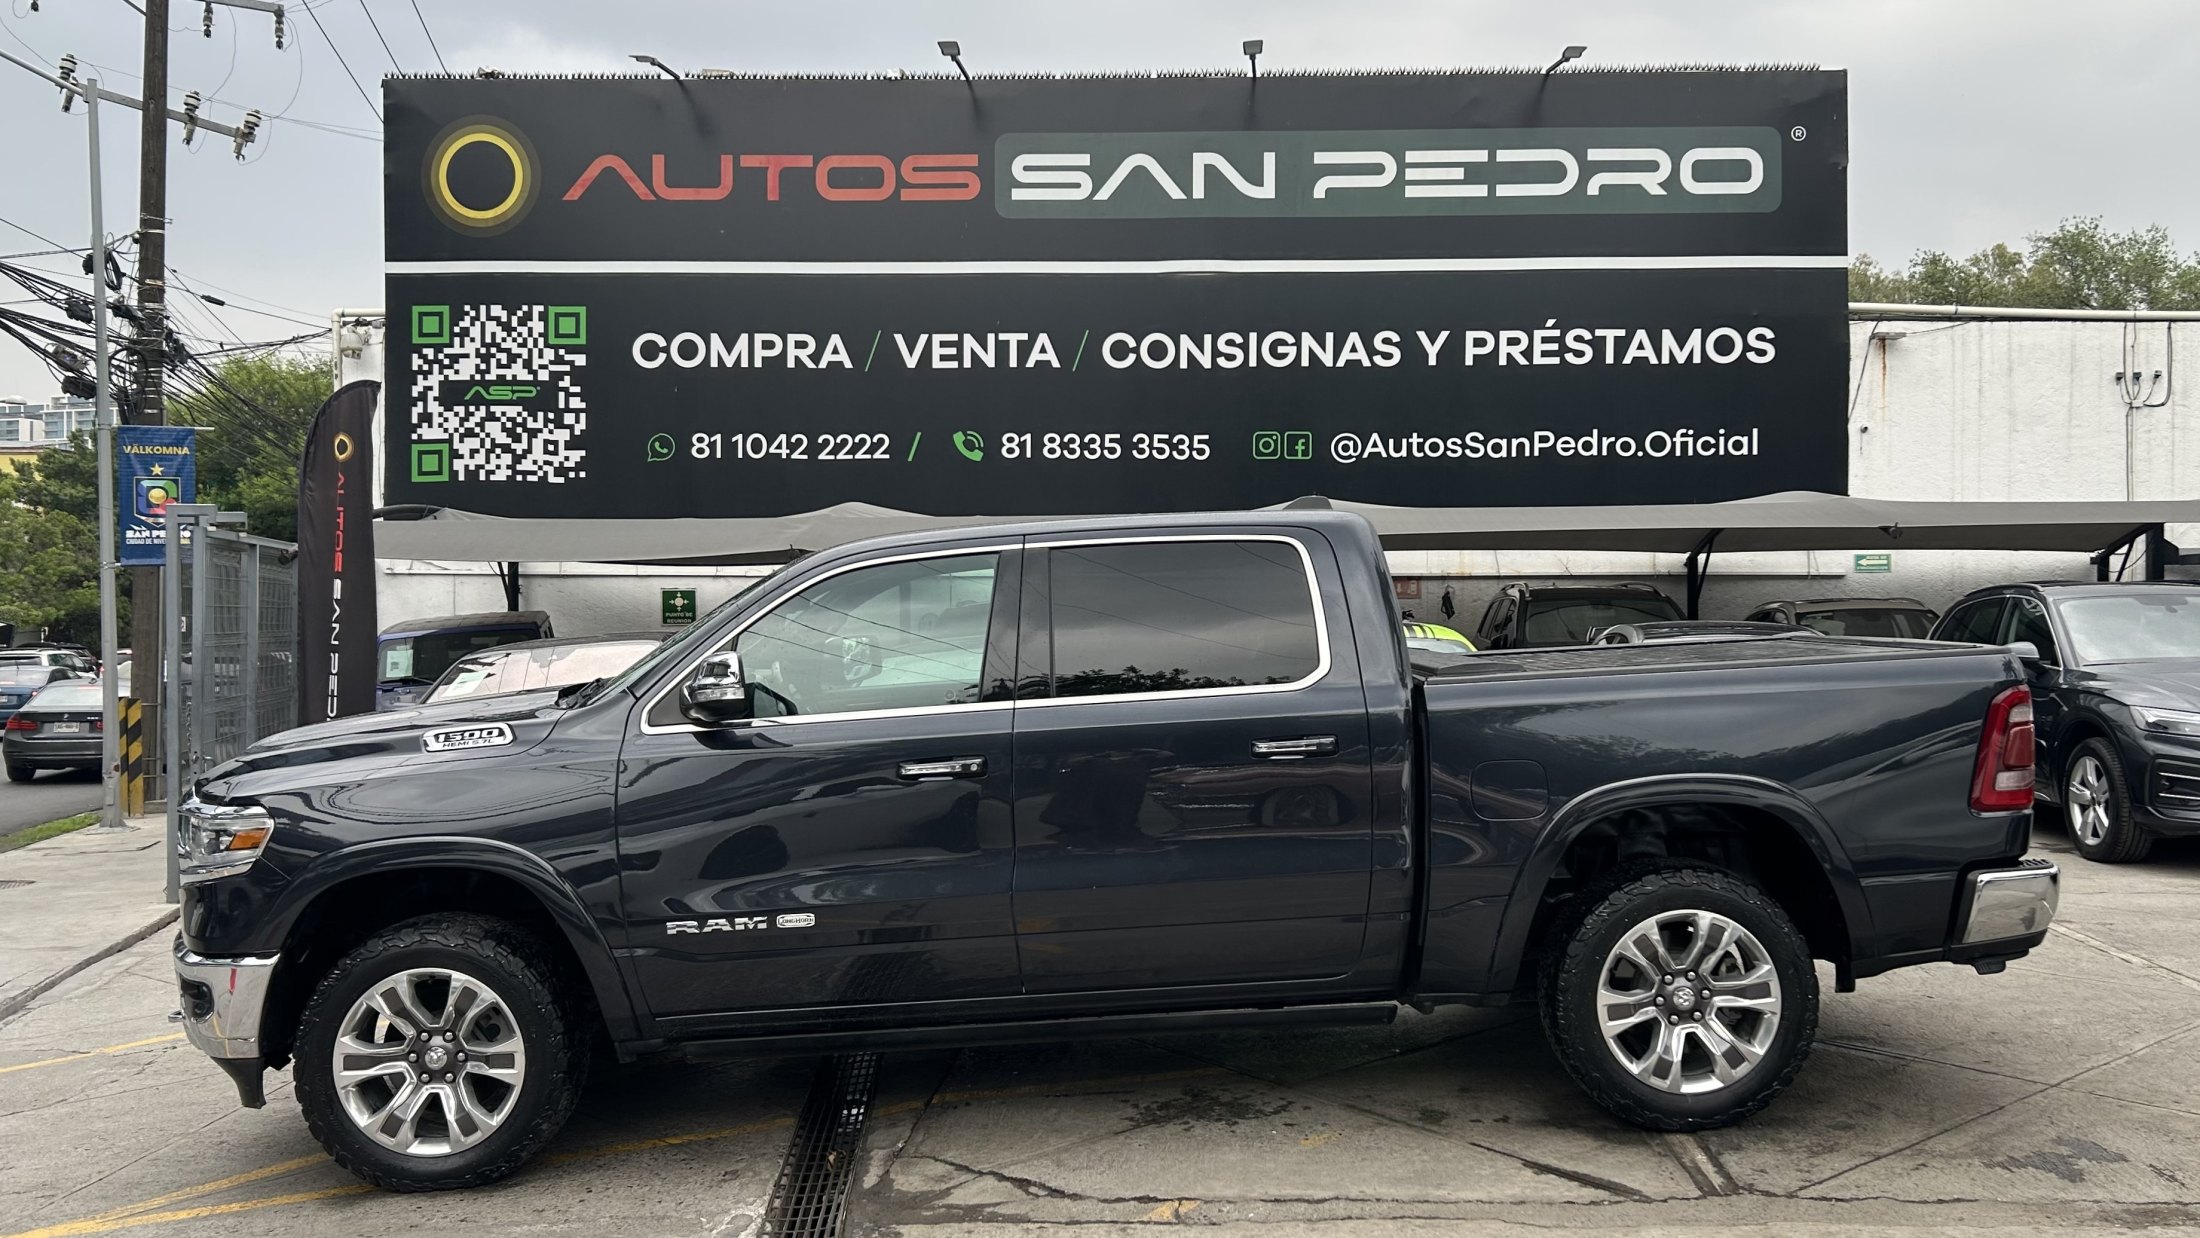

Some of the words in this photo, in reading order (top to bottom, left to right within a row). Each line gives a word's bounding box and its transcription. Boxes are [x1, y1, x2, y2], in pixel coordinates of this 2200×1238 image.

[562, 154, 980, 202] AUTOS
[1010, 151, 1276, 201] SAN
[1313, 147, 1764, 199] PEDRO
[632, 331, 854, 369] COMPRA
[893, 332, 1061, 369] VENTA
[1101, 330, 1402, 370] CONSIGNAS
[1415, 330, 1451, 366] Y
[1464, 318, 1776, 366] PRÉSTAMOS
[463, 385, 537, 401] ASP
[122, 443, 190, 455] VÄLKOMNA
[691, 432, 722, 459] 81
[731, 432, 809, 460] 1042
[817, 432, 890, 461] 2222
[1000, 432, 1032, 460] 81
[1042, 432, 1122, 460] 8335
[1131, 432, 1211, 461] 3535
[1330, 427, 1759, 464] @AutosSanPedro.Oficial
[331, 578, 342, 645] SAN
[327, 653, 339, 721] PED
[437, 727, 501, 743] 1500
[442, 740, 469, 748] HEMI
[665, 915, 768, 935] RAM
